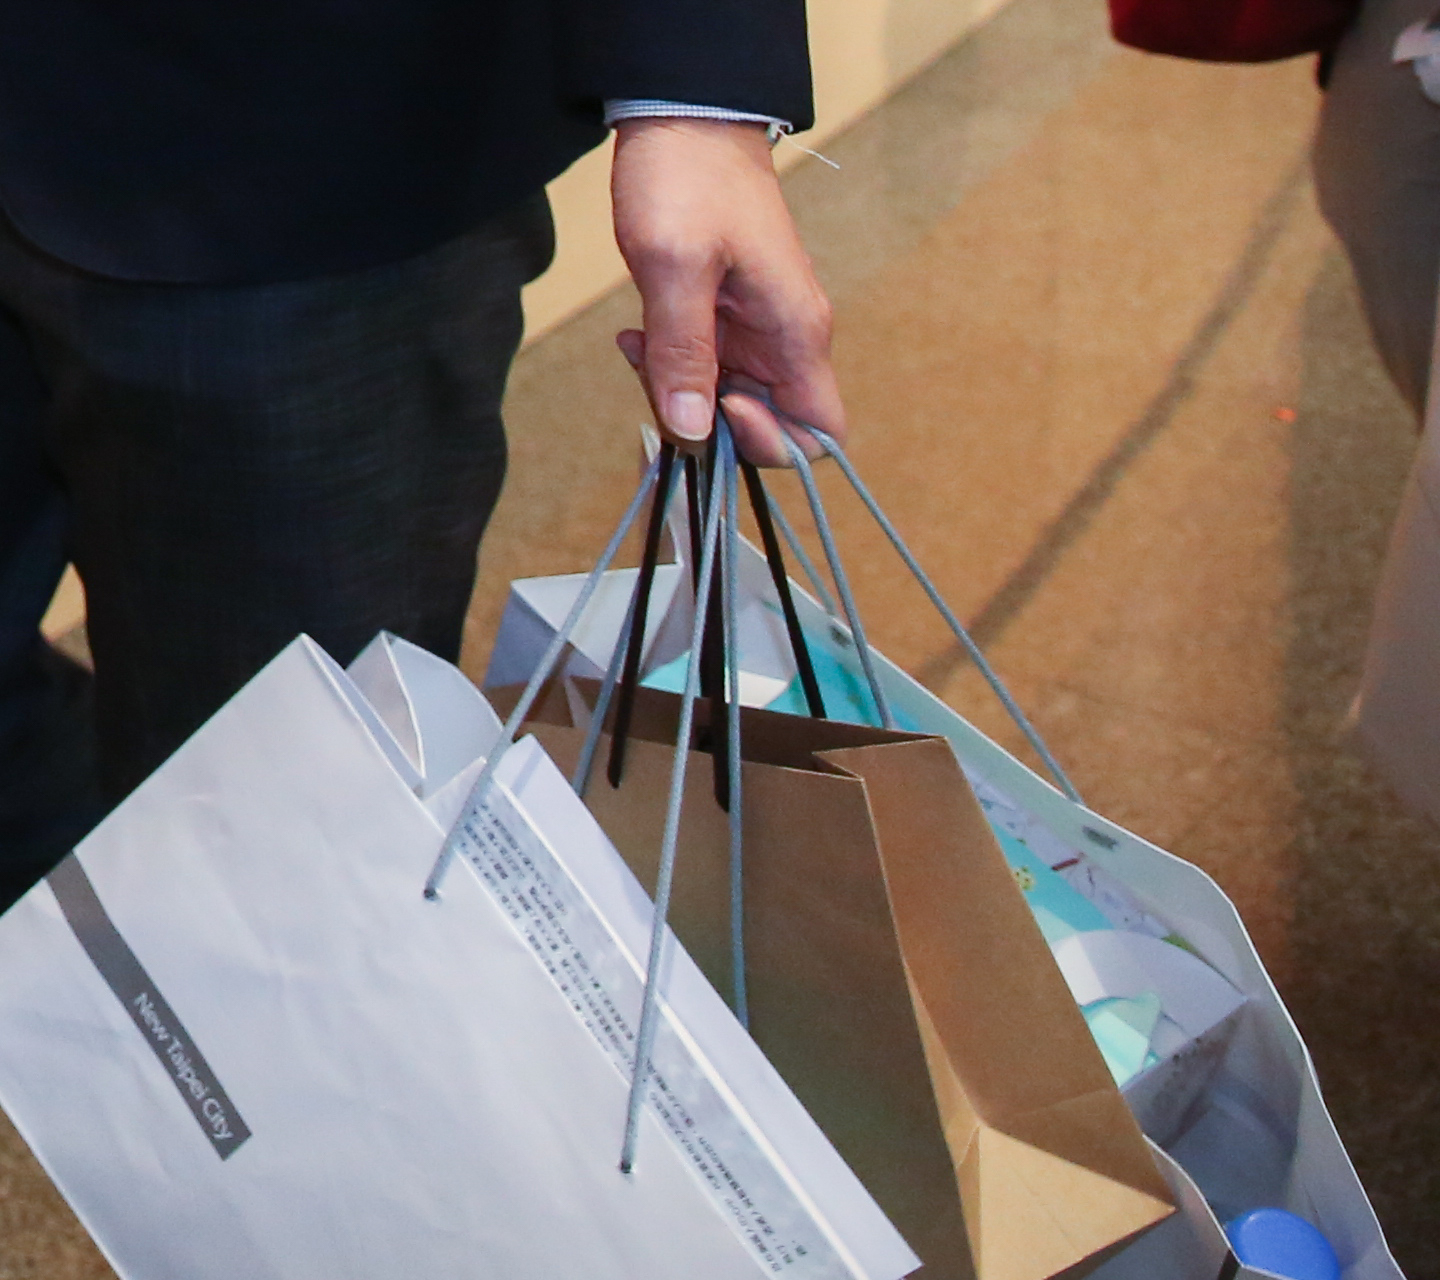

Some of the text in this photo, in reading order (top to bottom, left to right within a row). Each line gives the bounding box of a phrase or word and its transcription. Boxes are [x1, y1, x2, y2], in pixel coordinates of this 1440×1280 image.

[134, 992, 234, 1142] New Taipei City
